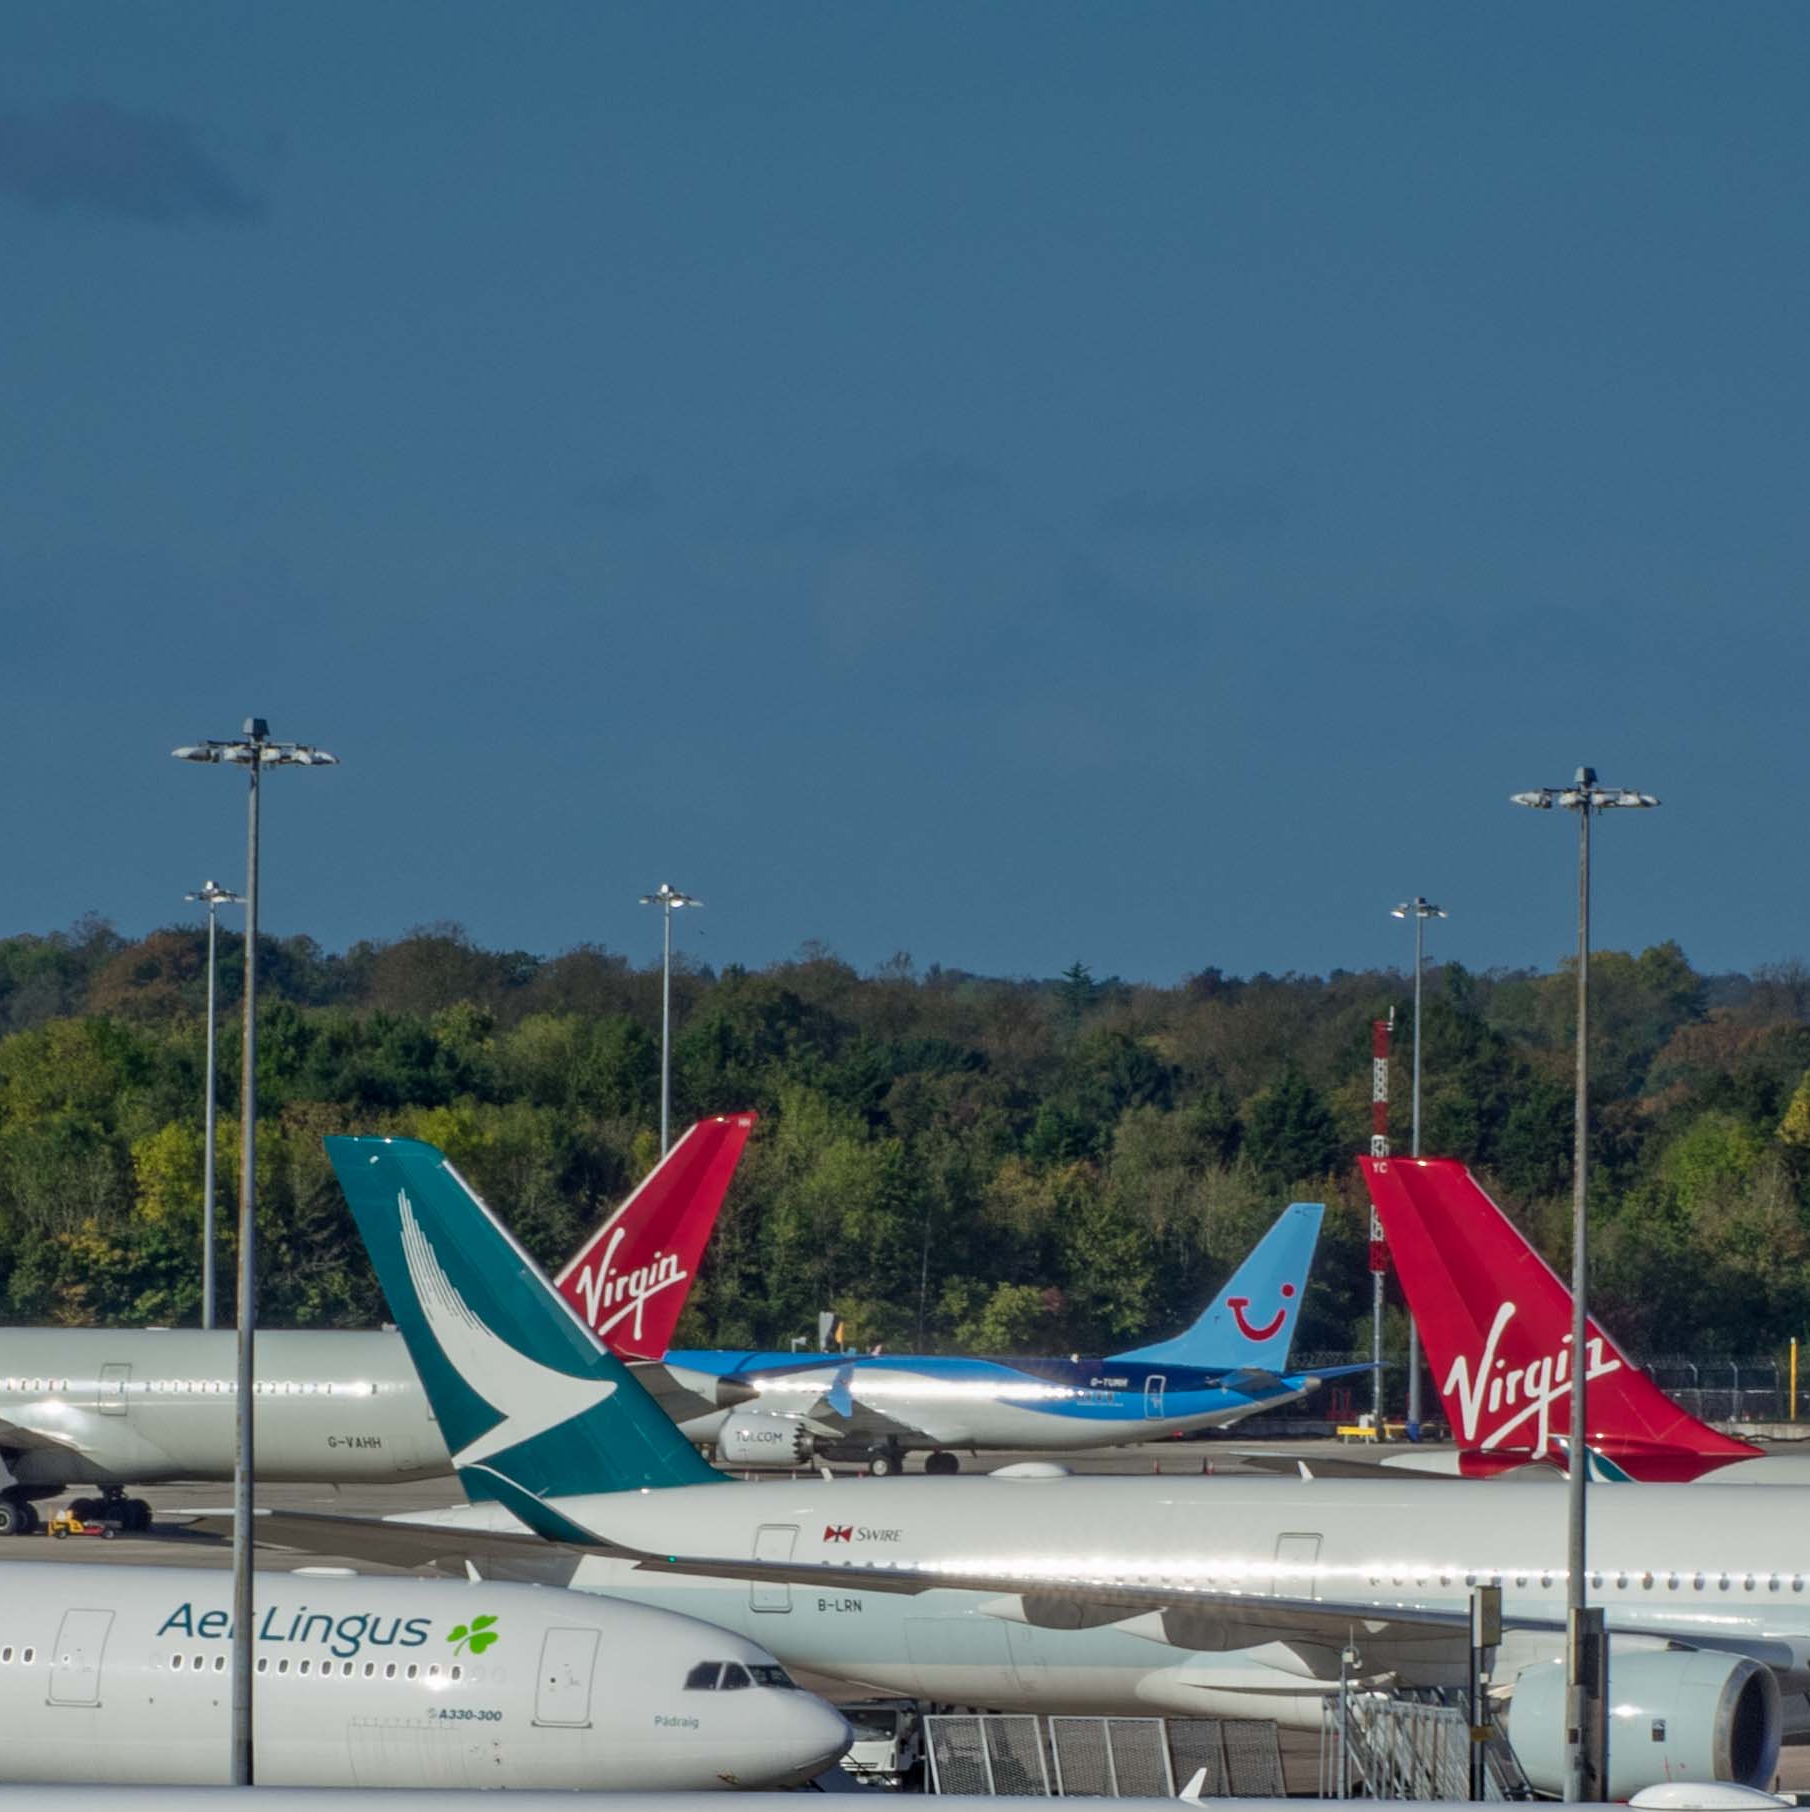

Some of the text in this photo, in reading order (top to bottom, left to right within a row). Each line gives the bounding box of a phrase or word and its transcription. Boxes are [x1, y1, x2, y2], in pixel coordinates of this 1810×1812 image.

[1372, 1161, 1389, 1174] YC
[575, 1227, 688, 1341] Virgin
[1442, 1301, 1622, 1460] Virgin
[327, 1435, 383, 1449] G-VAHH
[855, 1526, 903, 1543] SWIRE
[817, 1597, 863, 1613] B-LRN
[156, 1602, 432, 1658] Ae Lingus
[438, 1709, 503, 1722] A330-300
